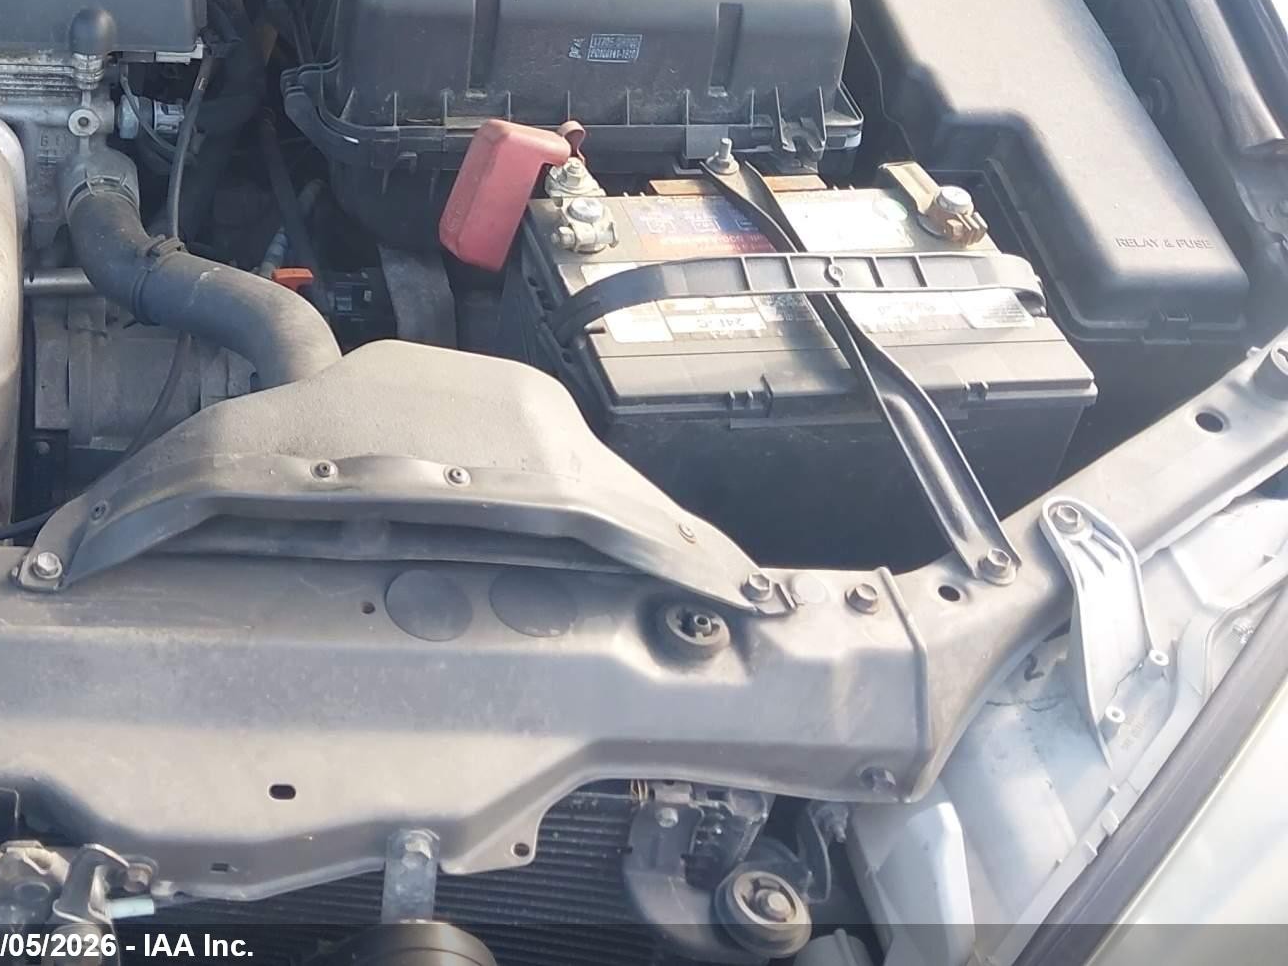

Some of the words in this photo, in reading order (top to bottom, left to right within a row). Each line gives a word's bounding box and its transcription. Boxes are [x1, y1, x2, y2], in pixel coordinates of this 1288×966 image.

[1115, 238, 1159, 248] RELAY
[1162, 239, 1175, 248] &
[1176, 239, 1215, 249] FUSE
